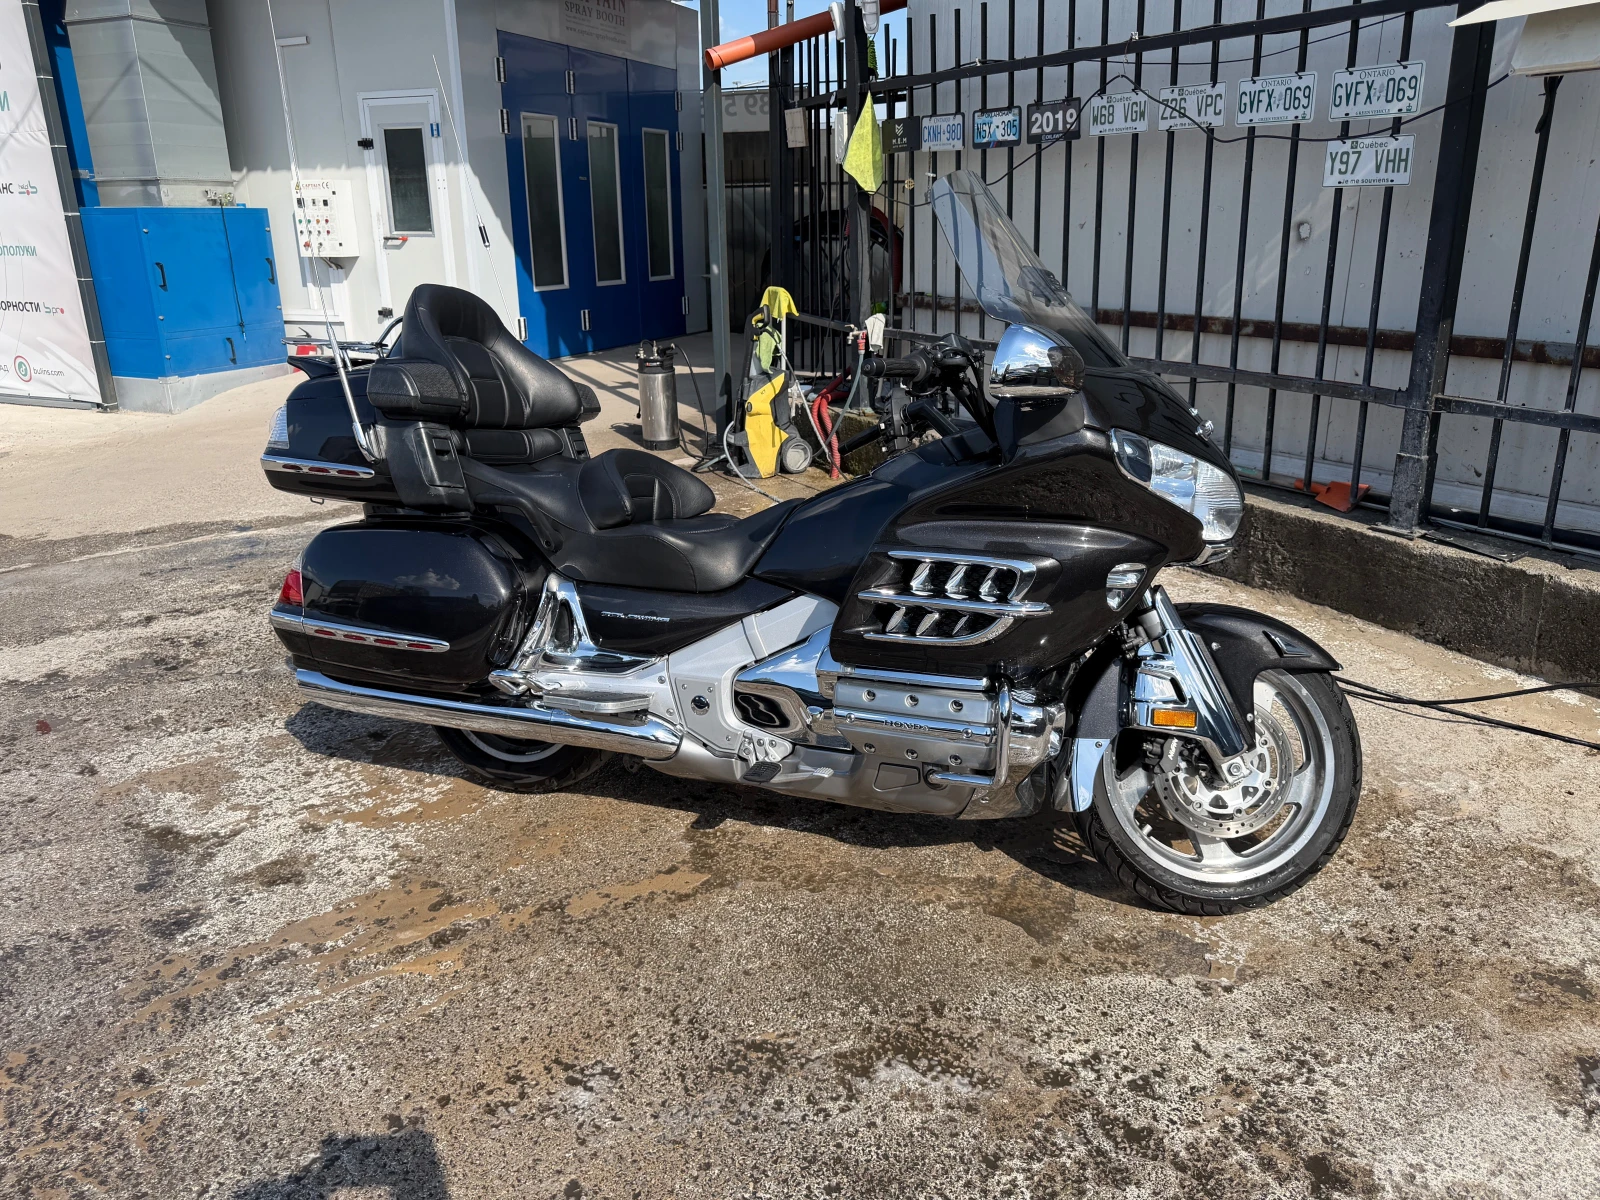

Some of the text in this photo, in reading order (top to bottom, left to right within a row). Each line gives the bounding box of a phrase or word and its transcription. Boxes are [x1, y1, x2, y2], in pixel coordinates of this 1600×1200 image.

[565, 1, 592, 18] SPRAY
[596, 10, 625, 26] BOOTH
[1261, 78, 1292, 89] ONTARIO
[1360, 68, 1395, 80] ONTARIO
[1112, 96, 1132, 104] Québec
[1184, 88, 1207, 96] Québec
[1239, 85, 1312, 114] GVFX 069
[1334, 76, 1418, 108] GVFX 069
[1092, 100, 1146, 126] W68 VGW
[1160, 94, 1222, 120] Z26 VPC
[976, 120, 1018, 140] NSX 305
[1031, 108, 1077, 134] 2019
[922, 123, 962, 142] CKNH 980
[1358, 140, 1388, 149] Québec
[1329, 148, 1410, 176] Y97 VHH
[0, 300, 41, 312] ОРНОСТИ
[884, 720, 929, 732] HONDA
